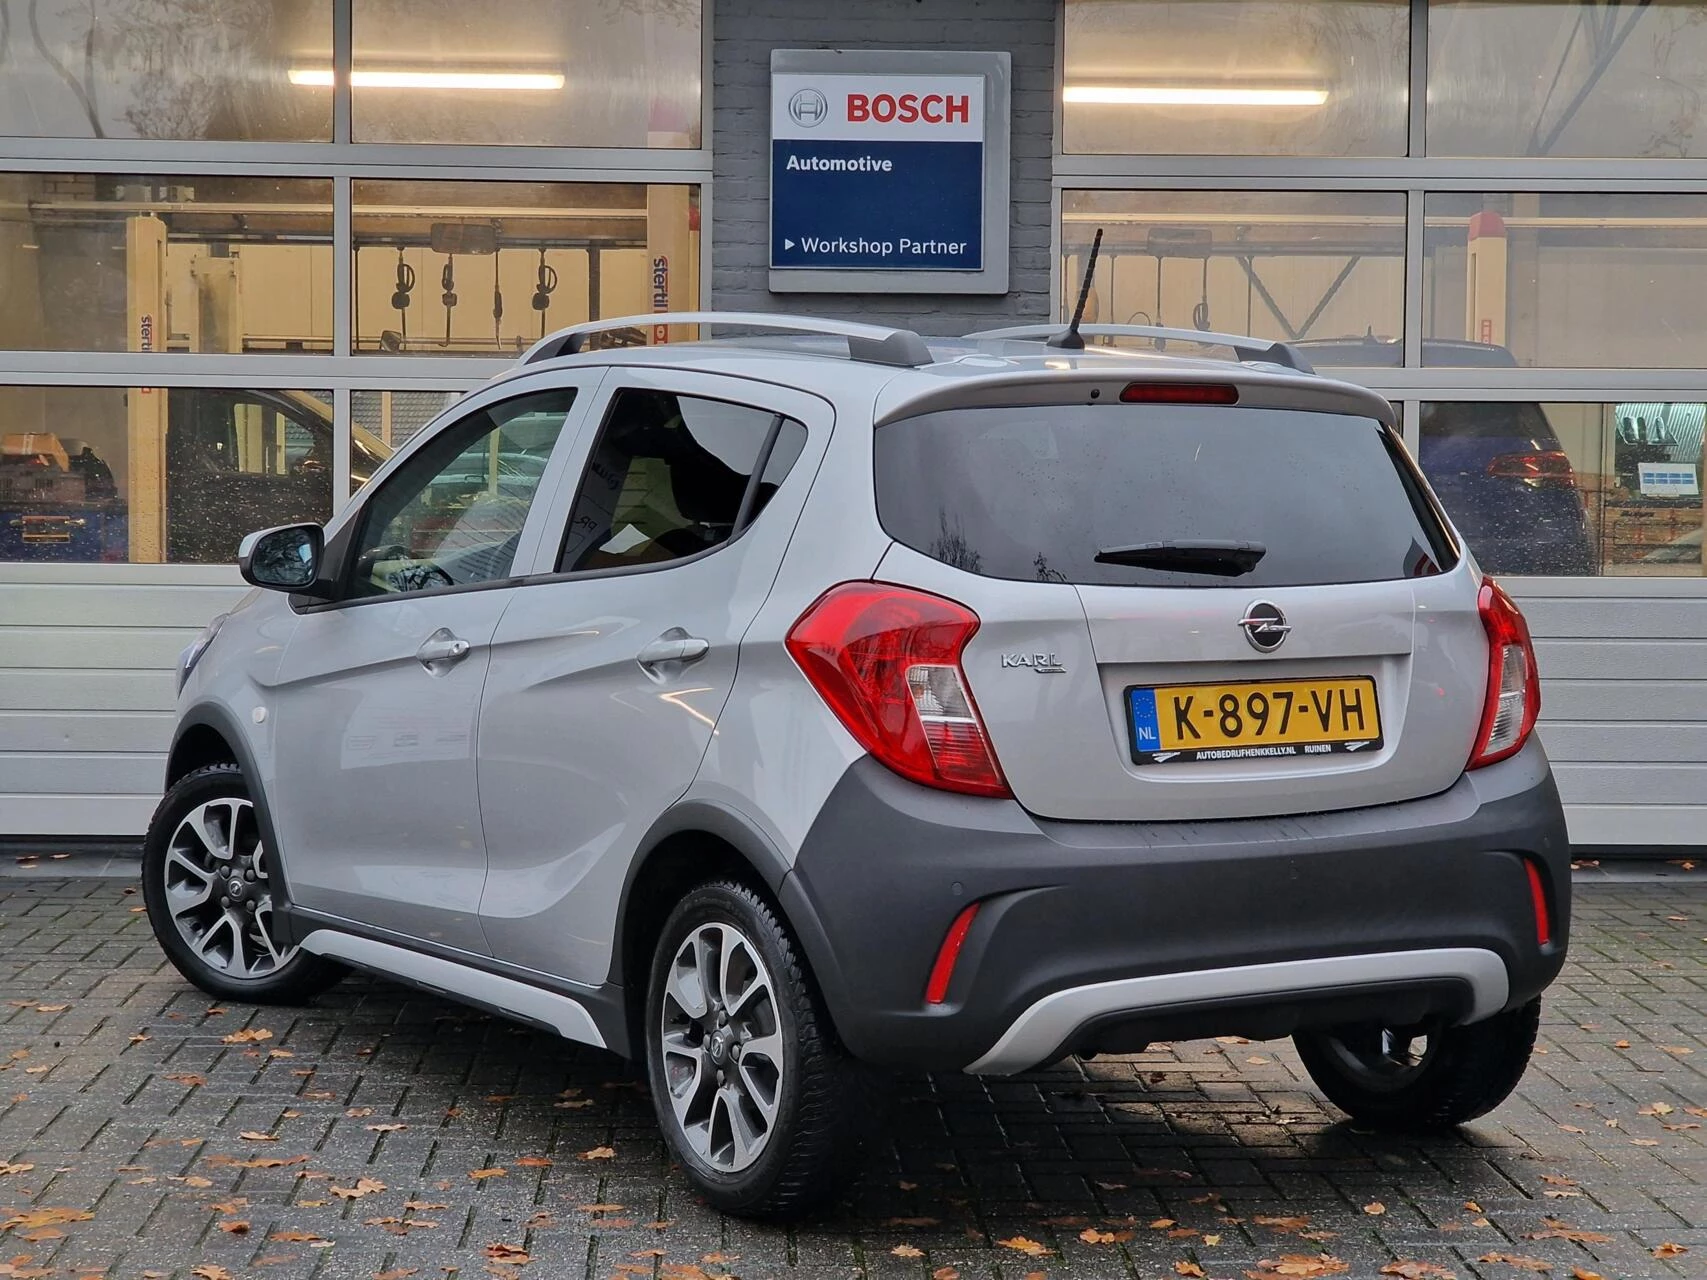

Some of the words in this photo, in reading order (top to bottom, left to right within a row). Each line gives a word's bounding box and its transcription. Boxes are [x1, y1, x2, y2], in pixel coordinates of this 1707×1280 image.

[847, 94, 969, 123] BOSCH
[786, 155, 893, 172] Automotive
[801, 237, 893, 256] Workshop
[899, 238, 967, 254] Partner
[653, 257, 668, 308] stertil
[1001, 653, 1062, 668] KARL
[1173, 688, 1365, 740] K-897-VH
[1138, 726, 1157, 741] NL
[1304, 743, 1332, 754] RUINEN
